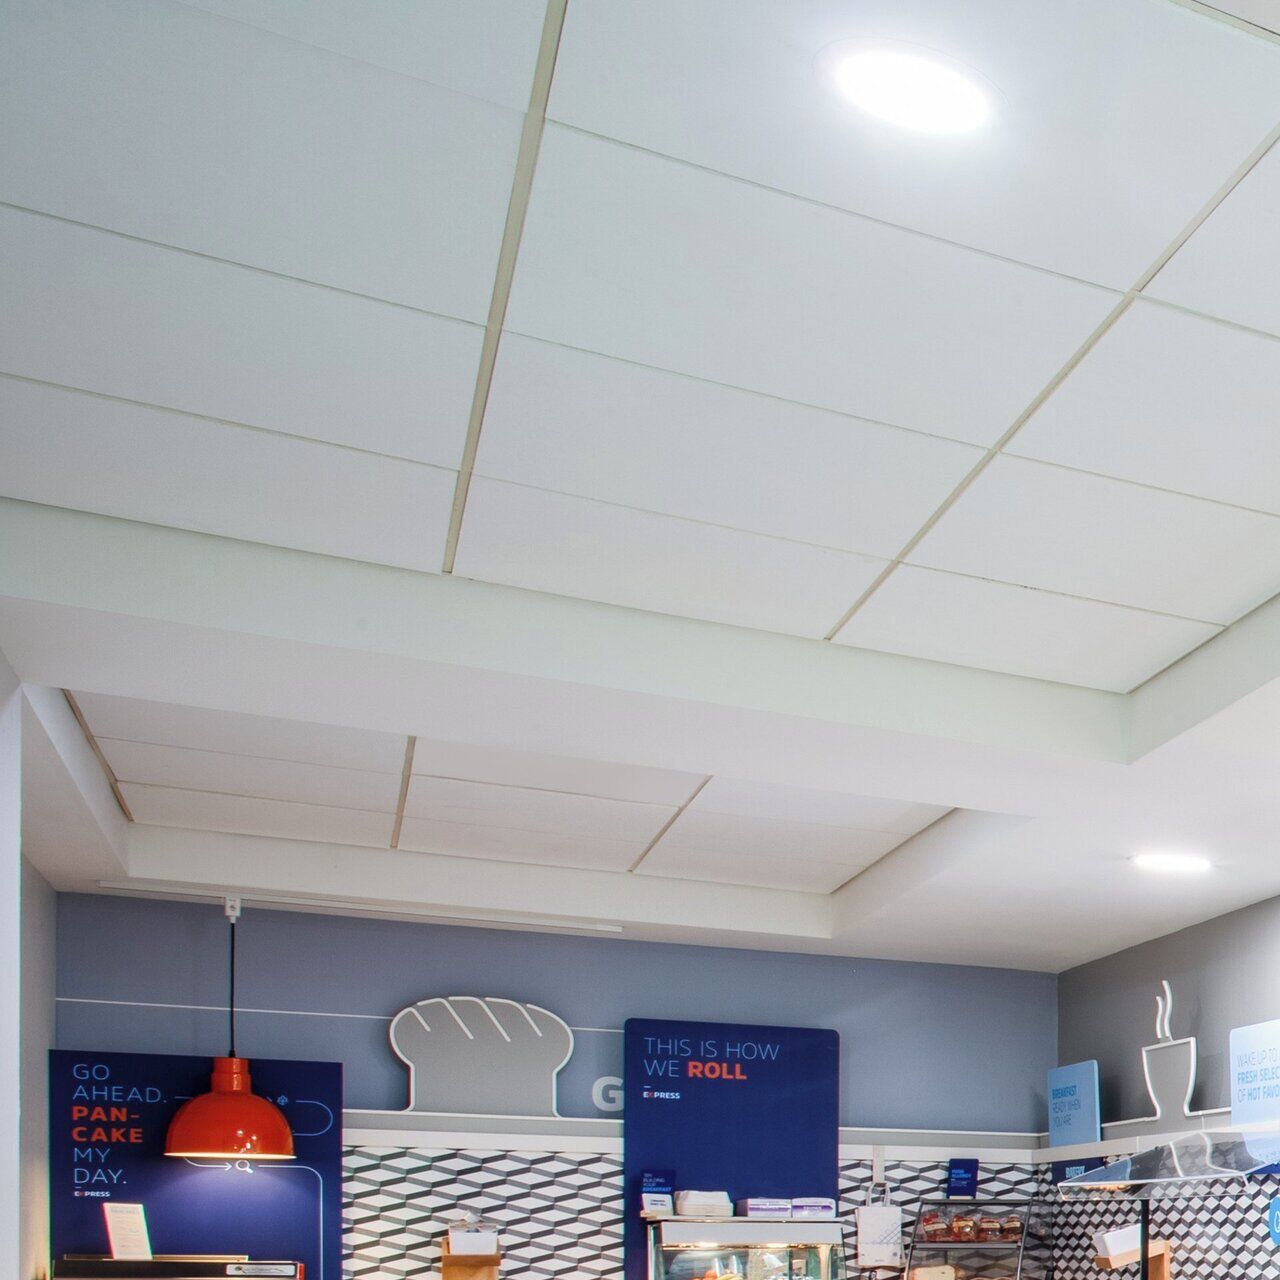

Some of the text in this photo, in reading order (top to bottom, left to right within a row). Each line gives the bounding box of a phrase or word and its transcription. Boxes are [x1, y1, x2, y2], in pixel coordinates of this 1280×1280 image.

[644, 1037, 780, 1061] THIS IS HOW
[1237, 1052, 1256, 1067] WAKE
[1257, 1050, 1268, 1064] UP
[1269, 1049, 1279, 1062] TO
[72, 1064, 110, 1081] GO
[643, 1059, 747, 1080] WE ROLL
[1237, 1069, 1258, 1084] FRESH
[72, 1085, 167, 1103] AHEAD.
[1237, 1089, 1247, 1103] OF
[1247, 1087, 1261, 1101] HOT
[72, 1105, 140, 1122] PAN-
[72, 1126, 144, 1143] CAKE
[74, 1147, 110, 1163] MY
[74, 1168, 127, 1184] DAY.
